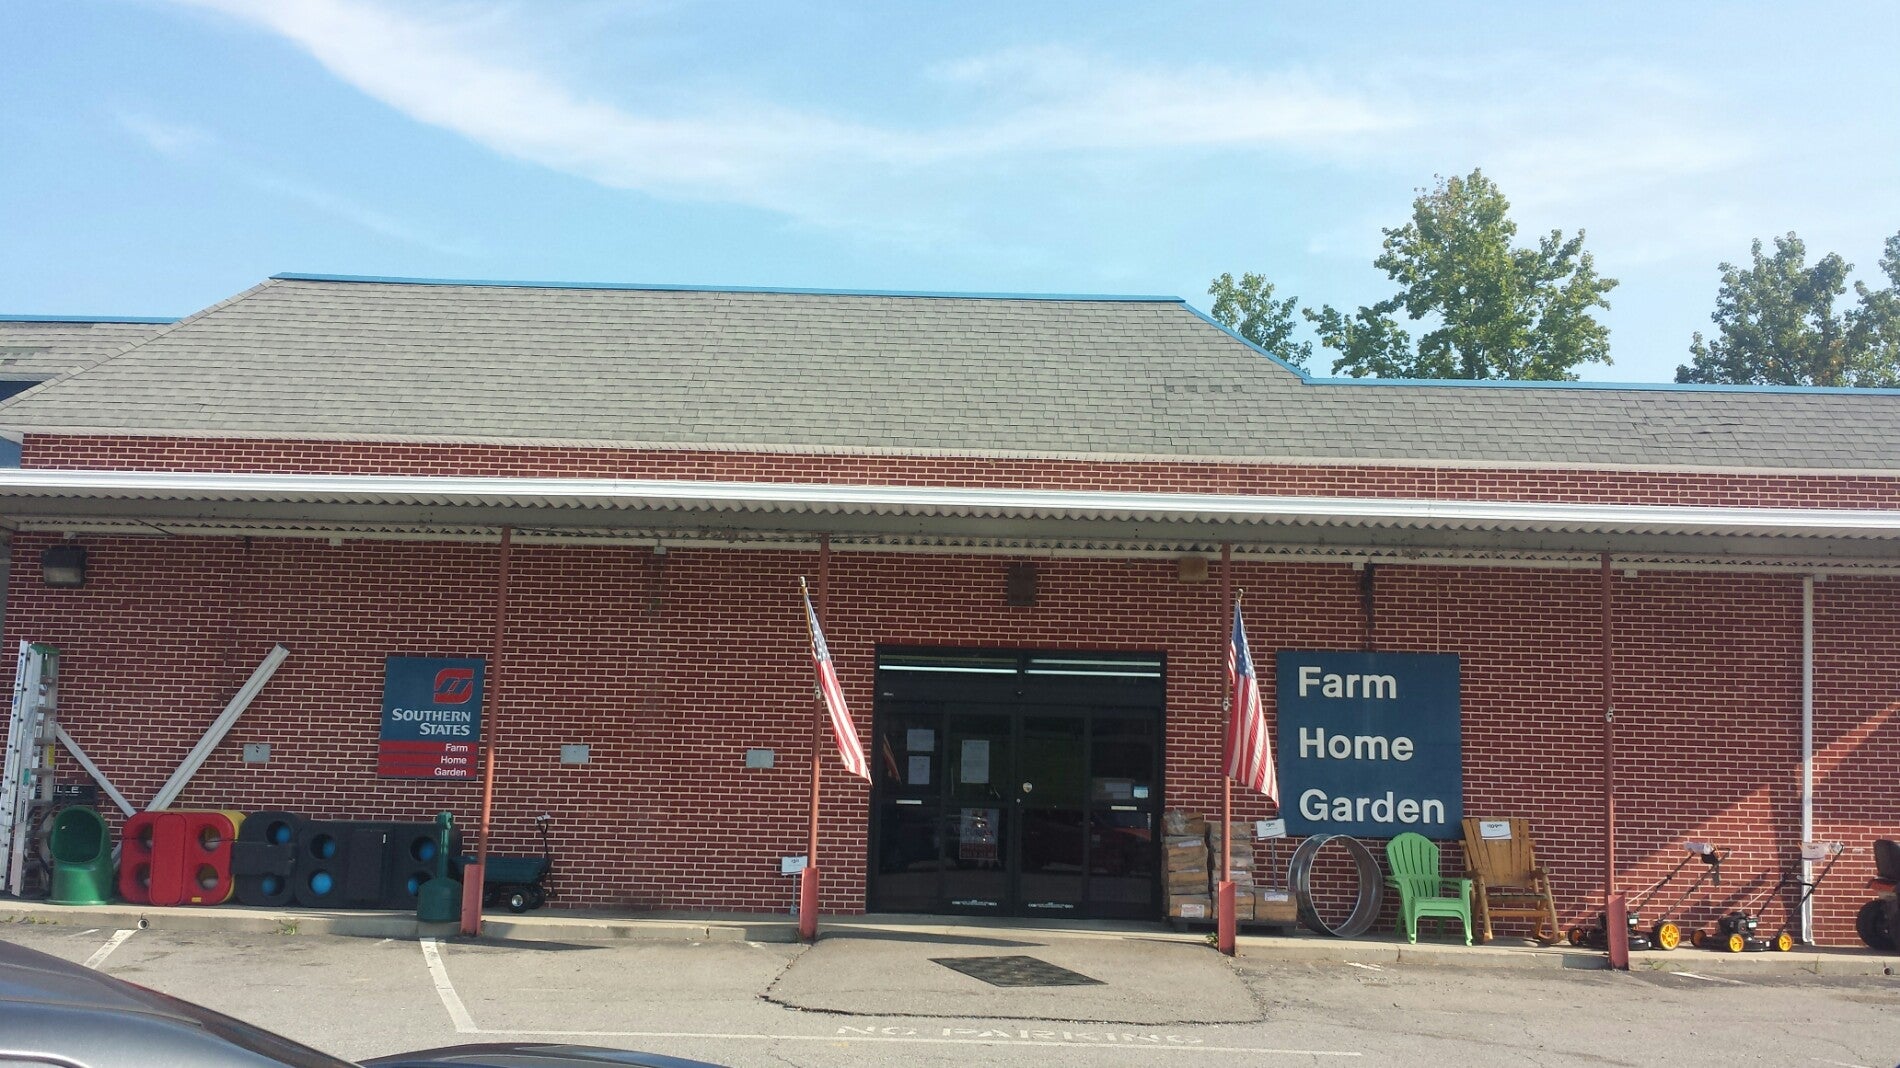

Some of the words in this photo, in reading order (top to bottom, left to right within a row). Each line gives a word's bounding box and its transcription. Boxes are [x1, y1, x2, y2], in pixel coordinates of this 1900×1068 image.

[1298, 666, 1398, 699] Farm
[391, 708, 471, 723] SOUTHERN
[419, 722, 471, 736] STATES
[445, 743, 468, 752] Farm
[1299, 727, 1414, 762] Home
[440, 756, 467, 765] Home
[434, 767, 467, 777] Garden
[1299, 788, 1445, 824] Garden
[836, 1025, 918, 1036] NO
[942, 1027, 1204, 1044] PARKING
